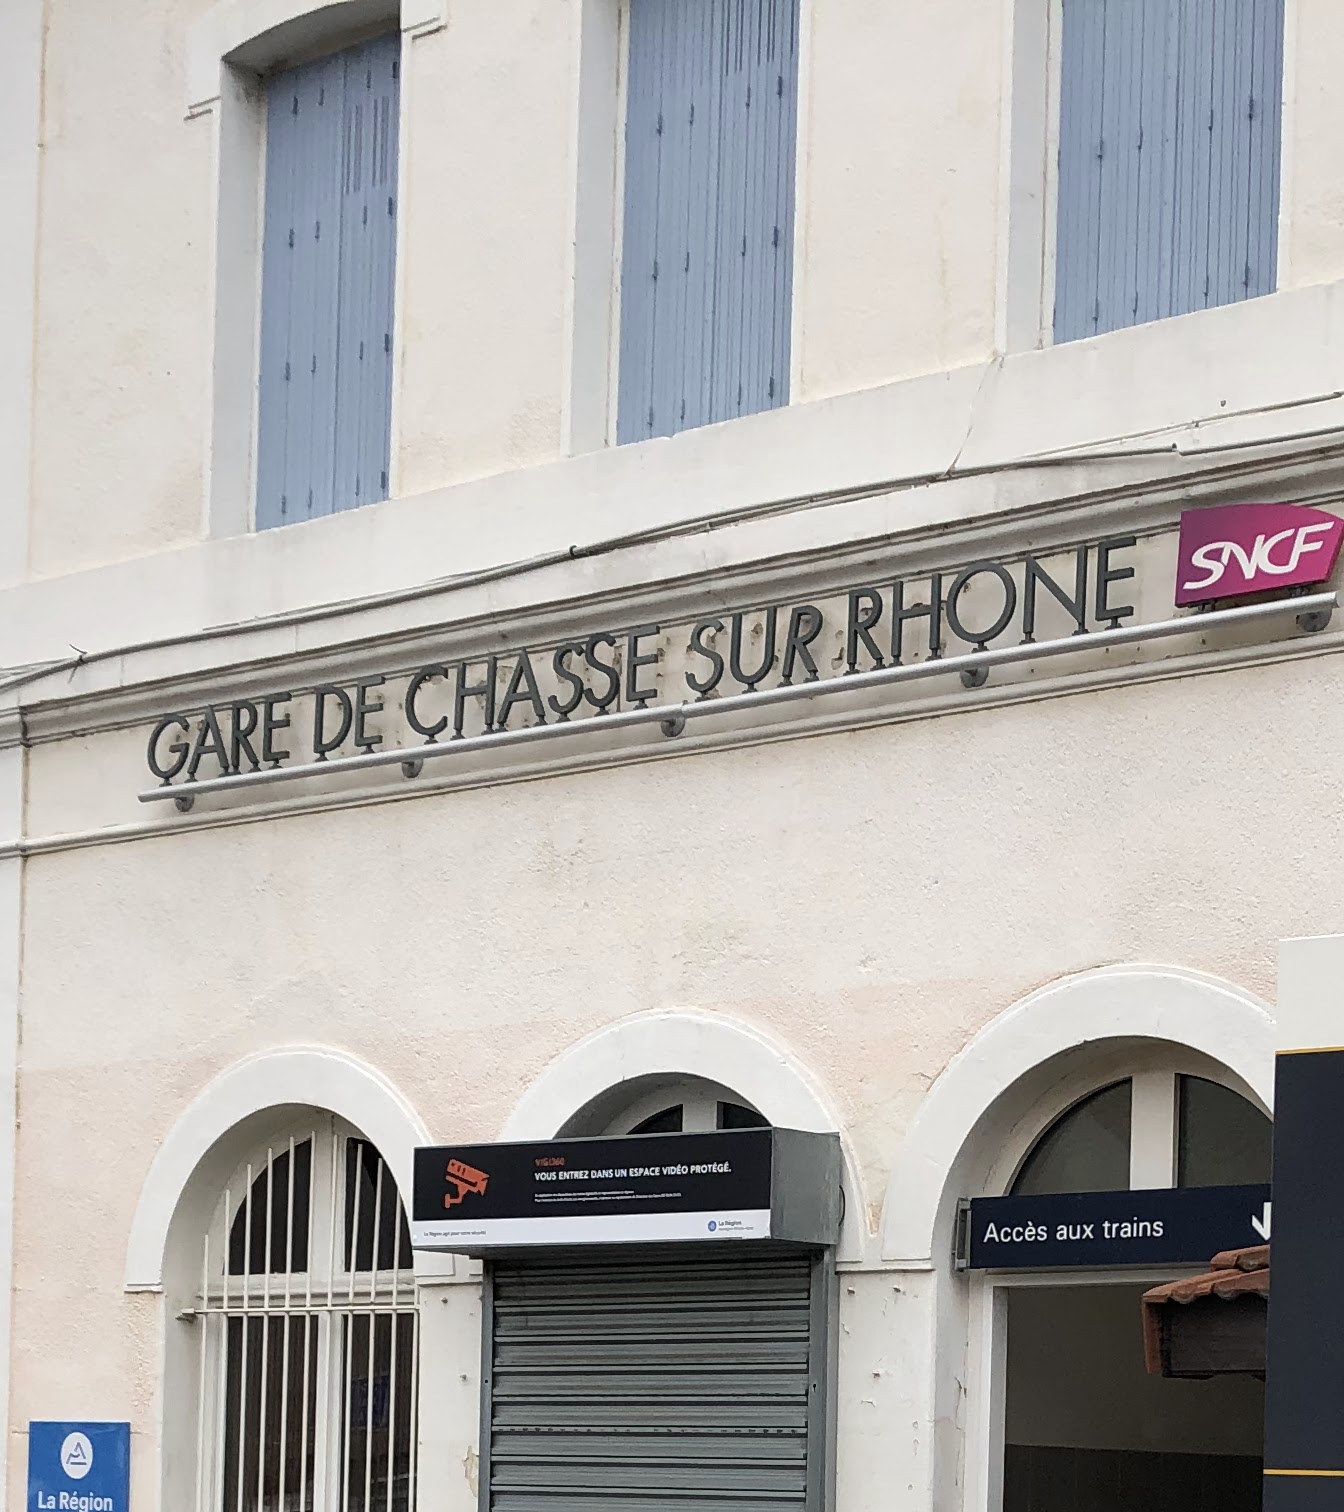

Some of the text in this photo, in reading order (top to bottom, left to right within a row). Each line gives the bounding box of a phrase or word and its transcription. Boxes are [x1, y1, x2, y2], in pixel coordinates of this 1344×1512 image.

[1183, 521, 1334, 589] SNCF
[148, 537, 1135, 780] GARE DE CHASSE SUR RHONE
[535, 1161, 732, 1181] VOUS ENTREZ DANS UN ESPACE VIDÉO PROTÉGÉ.
[983, 1217, 1164, 1243] Accès aux trains
[38, 1491, 56, 1509] La
